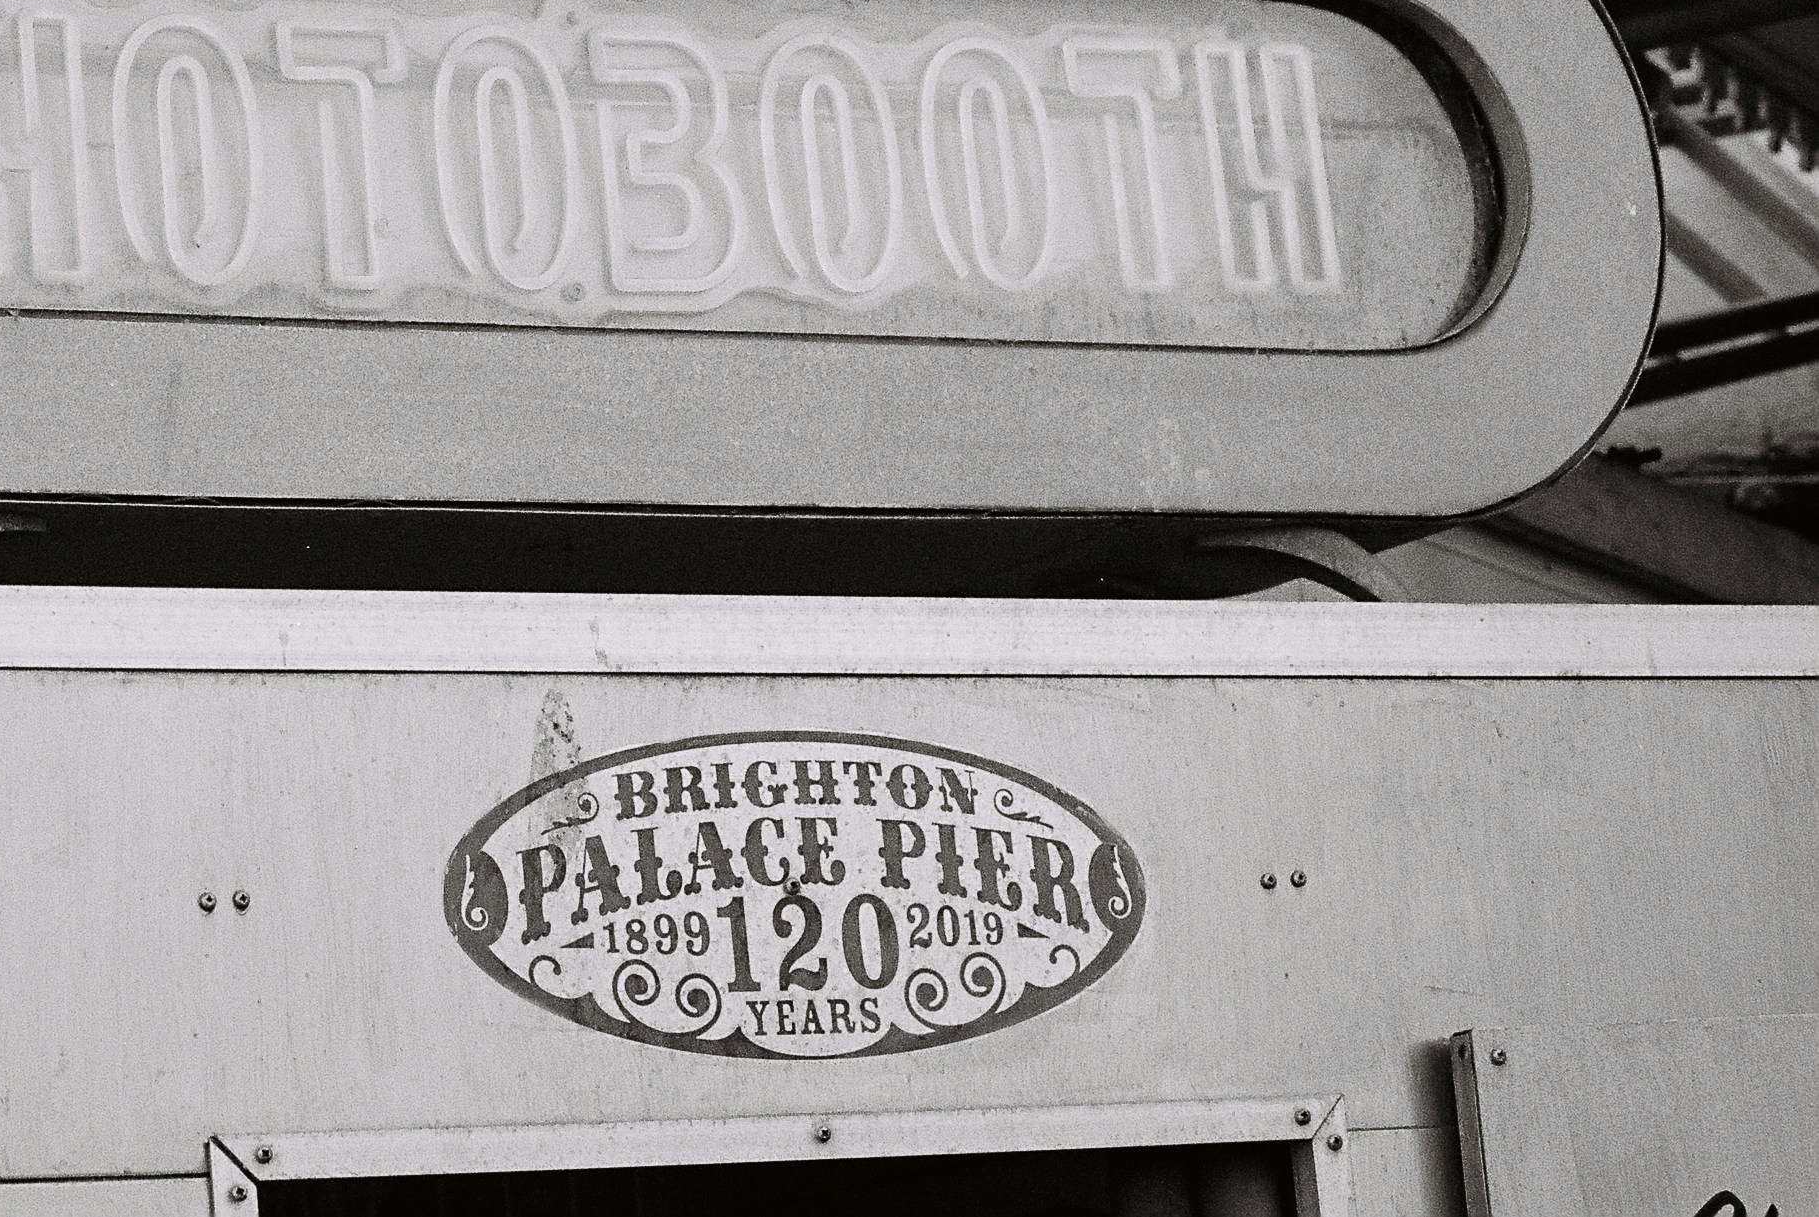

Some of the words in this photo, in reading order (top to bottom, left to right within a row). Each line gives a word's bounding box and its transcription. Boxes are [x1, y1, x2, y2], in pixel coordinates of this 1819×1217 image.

[613, 759, 982, 822] BRIGHTON
[516, 816, 847, 946] PALACE
[878, 818, 1090, 933] PIER
[600, 910, 712, 956] 1899
[716, 893, 900, 993] 120
[906, 903, 1005, 949] 2019
[745, 997, 882, 1037] YEARS
